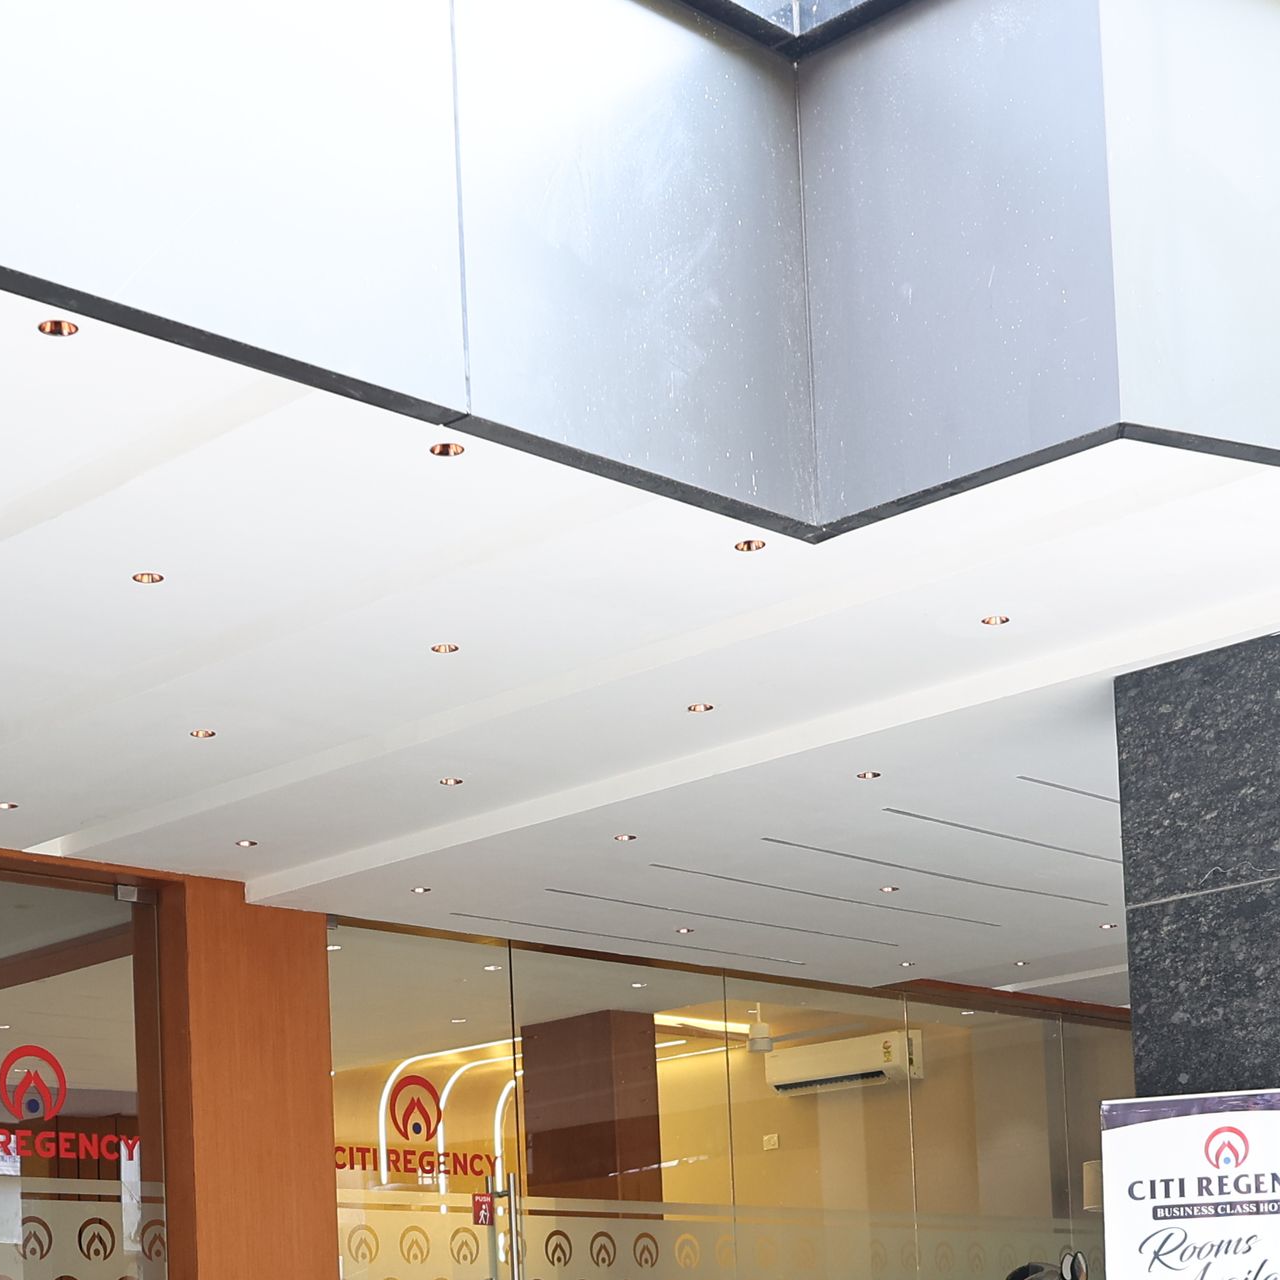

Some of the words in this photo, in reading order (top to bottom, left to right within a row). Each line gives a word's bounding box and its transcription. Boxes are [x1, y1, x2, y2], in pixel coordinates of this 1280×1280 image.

[335, 1146, 378, 1172] CITI
[387, 1149, 501, 1177] REGENCY
[1128, 1178, 1185, 1201] CITI
[1156, 1206, 1215, 1218] BUSINESS
[1217, 1203, 1257, 1214] CLASS
[1138, 1227, 1262, 1273] Rooms
